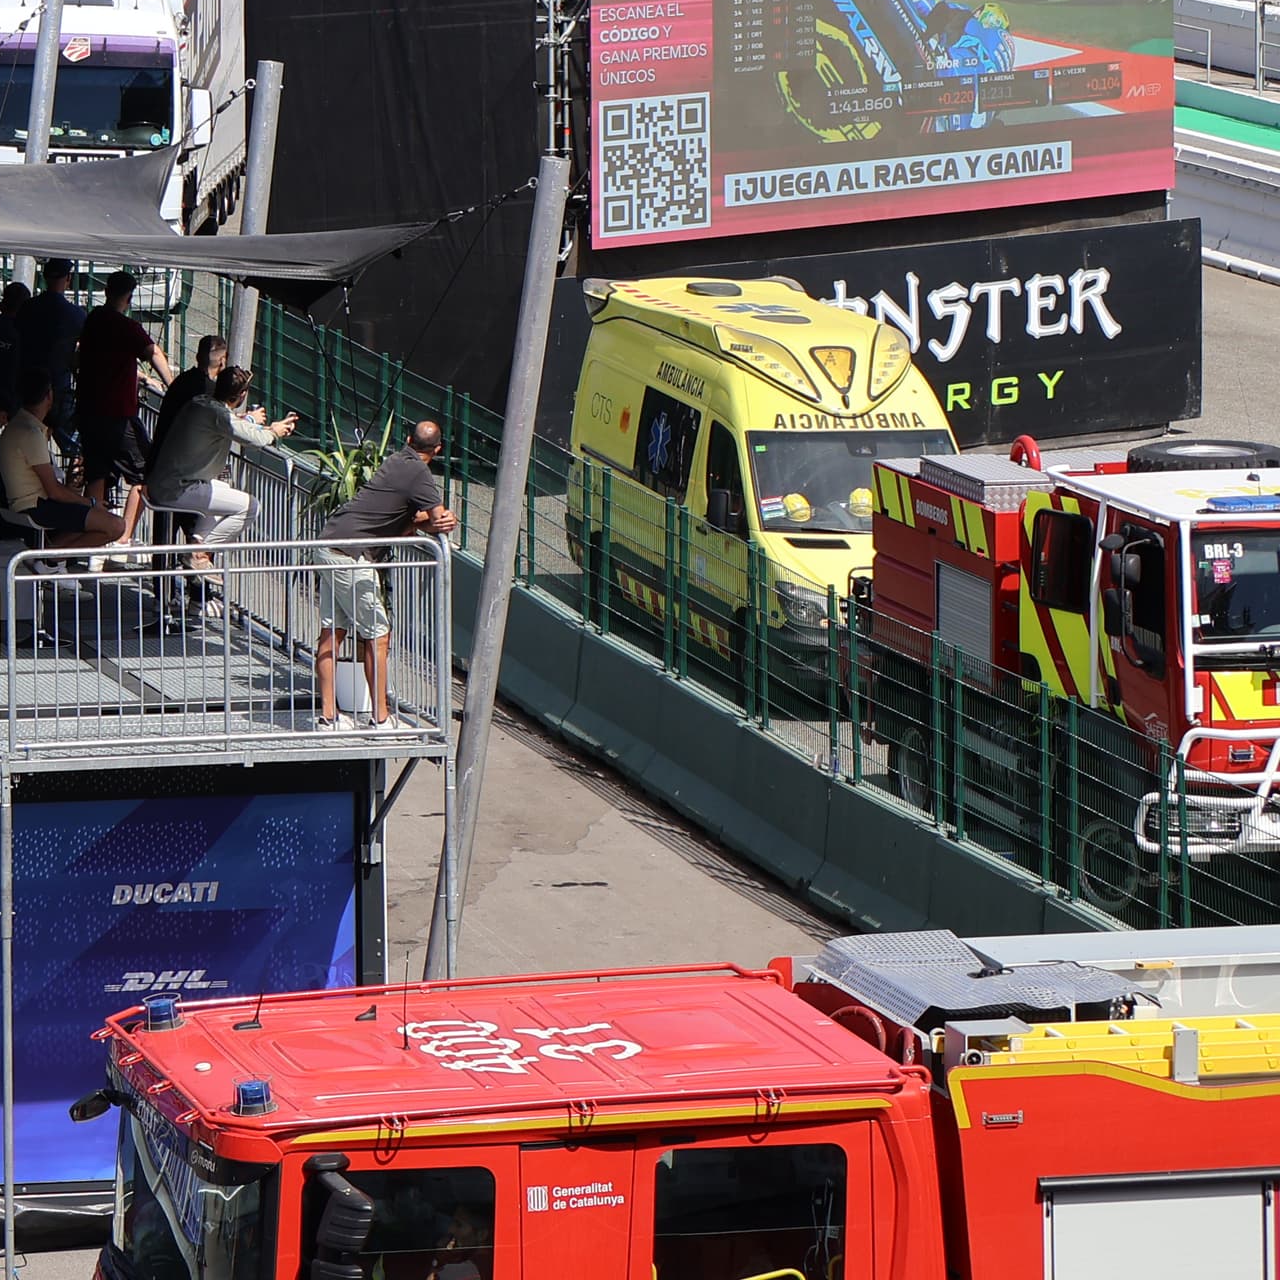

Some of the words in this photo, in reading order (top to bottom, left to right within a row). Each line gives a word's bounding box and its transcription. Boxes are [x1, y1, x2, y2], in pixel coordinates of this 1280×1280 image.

[600, 4, 665, 22] ESCANEA
[667, 3, 685, 17] EL
[600, 24, 660, 43] CÓDIGO
[662, 25, 672, 38] Y
[600, 49, 640, 65] GANA
[643, 43, 708, 61] PREMIOS
[964, 57, 978, 66] 10
[600, 68, 656, 86] ÚNICOS
[829, 97, 893, 114] 1:41.860
[938, 91, 974, 105] +0.220
[734, 170, 831, 202] ¡JUEGA
[836, 167, 868, 191] AL
[874, 157, 959, 188] RASCA
[965, 155, 981, 178] Y
[987, 147, 1064, 176] GANA!
[823, 267, 1123, 363] NSTER
[947, 370, 1064, 412] RGY
[591, 392, 612, 424] CTS
[915, 498, 948, 526] BOMBEROS
[1204, 542, 1243, 559] BRL-3
[111, 880, 219, 906] DUCATI
[116, 969, 216, 993] DHL
[552, 1182, 612, 1199] Generalitat
[552, 1198, 566, 1210] de
[568, 1193, 625, 1210] Catalunya
